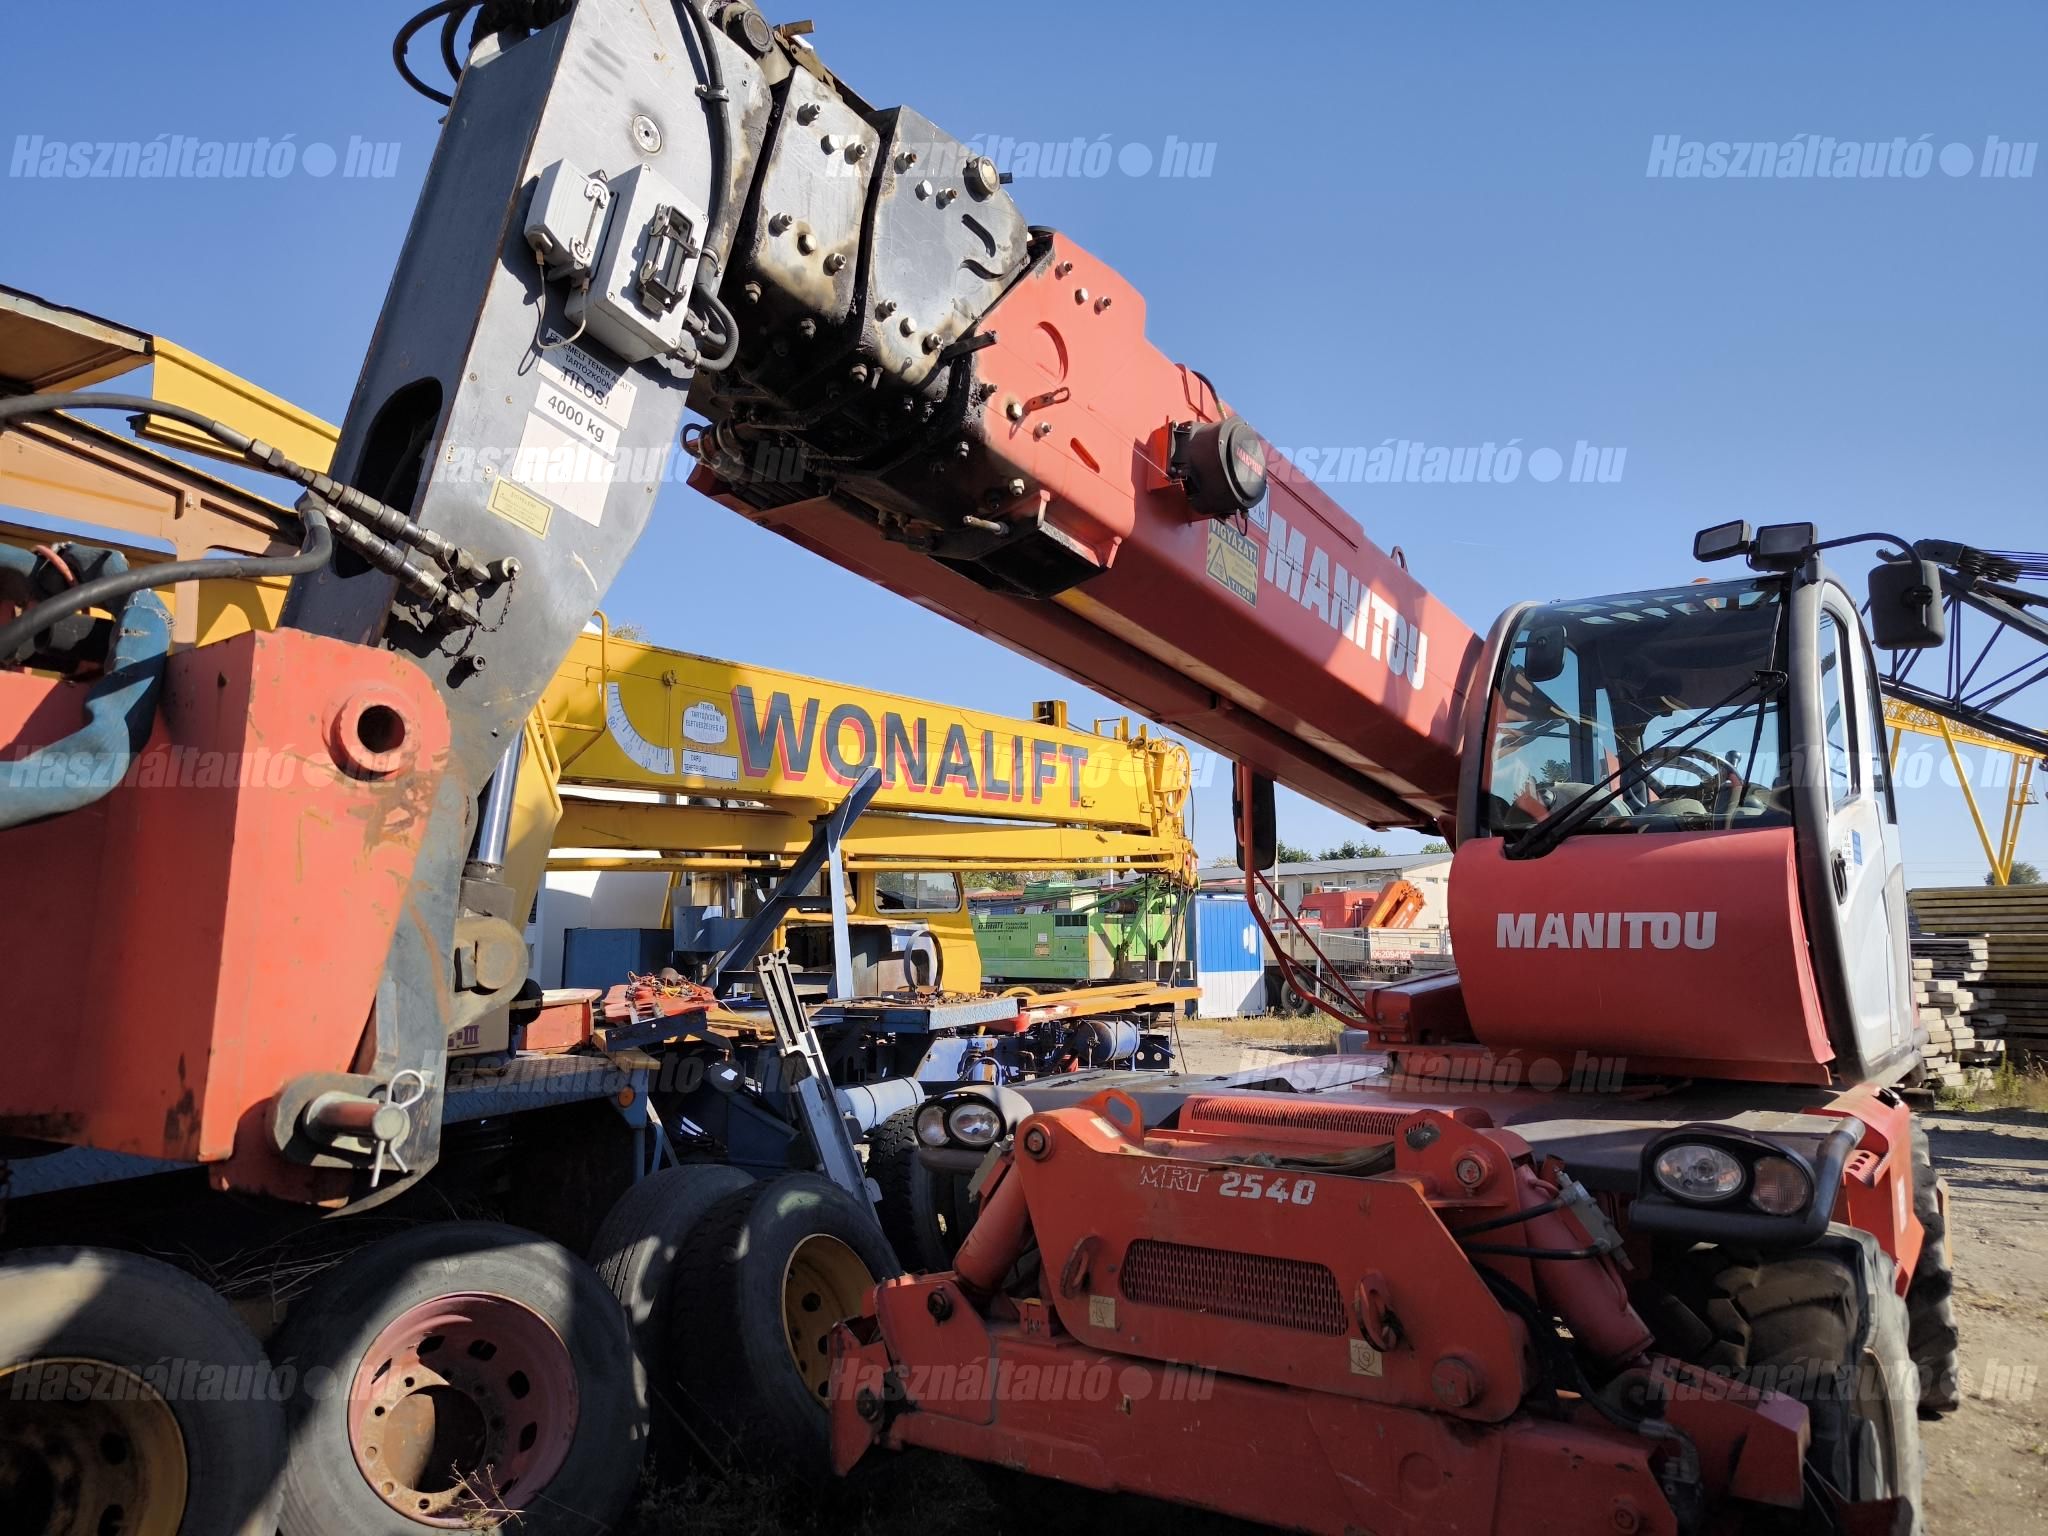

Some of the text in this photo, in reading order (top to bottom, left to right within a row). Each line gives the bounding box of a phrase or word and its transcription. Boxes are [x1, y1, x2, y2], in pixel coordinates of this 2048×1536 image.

[561, 365, 610, 409] TILOS!
[588, 356, 611, 379] TEHER
[548, 394, 604, 443] 4000 kg
[1210, 518, 1258, 563] VIGYÁZAT!
[1263, 510, 1428, 690] MANITOU
[731, 684, 1089, 807] WONALIFT
[1496, 911, 1717, 949] MANITOU
[1140, 1163, 1317, 1206] MRT 2540
